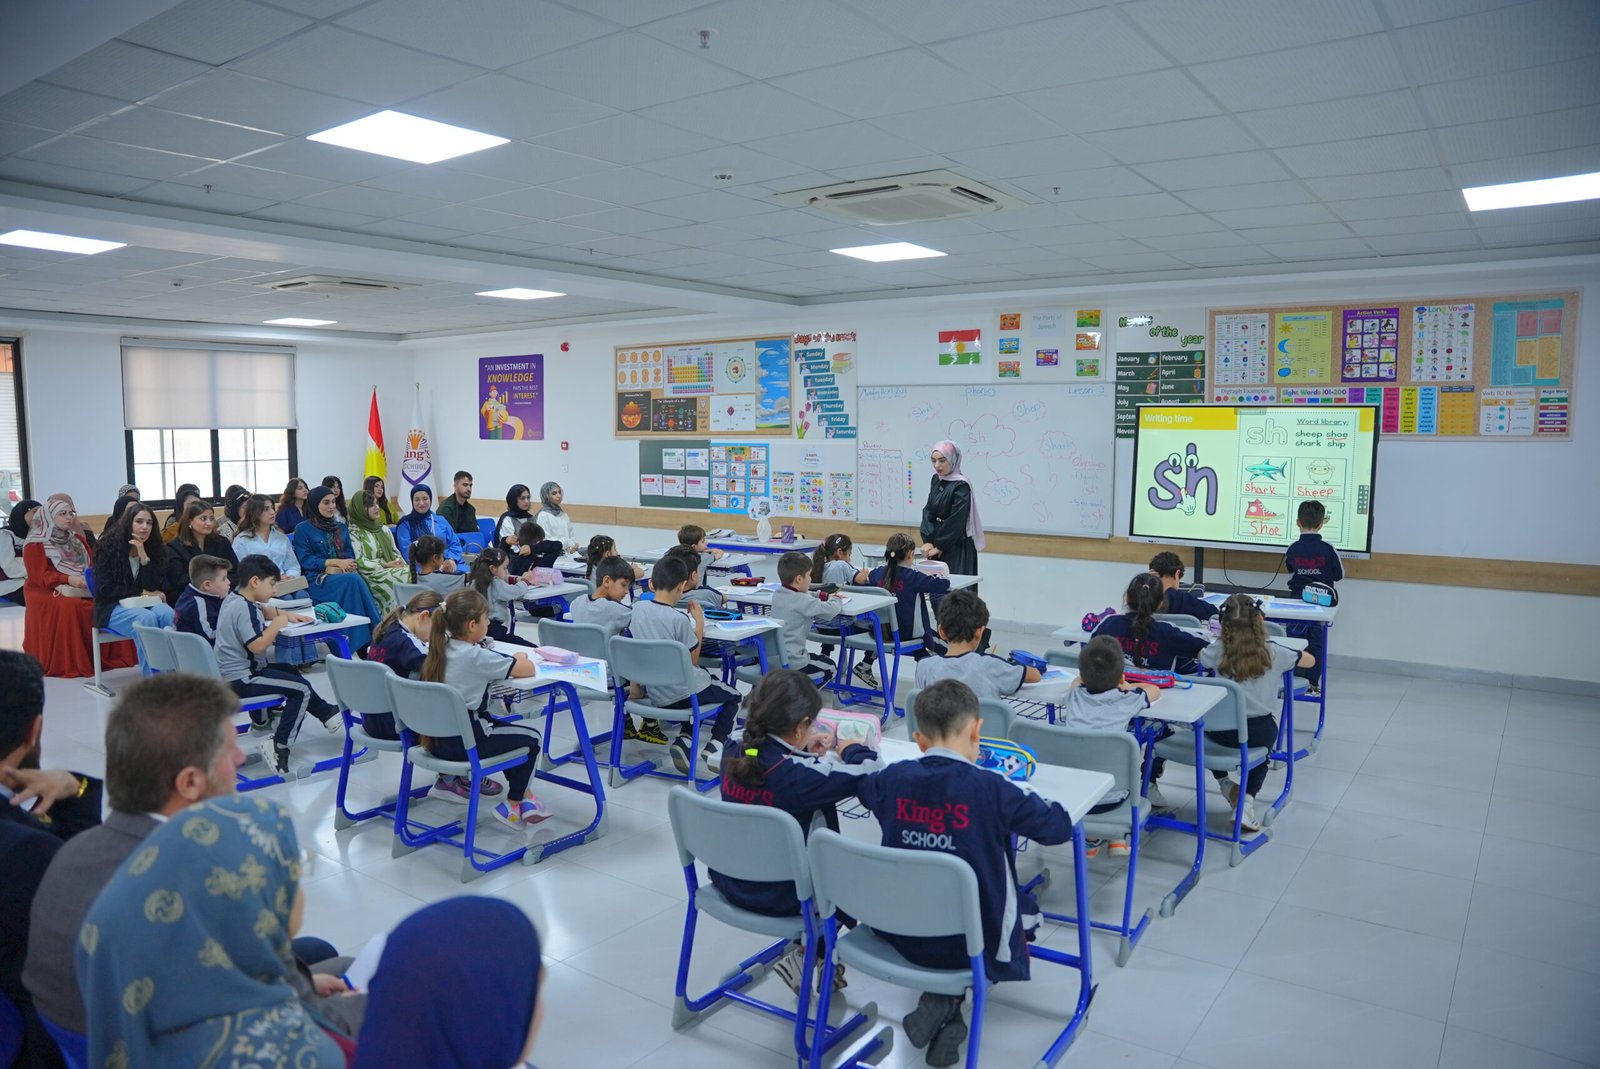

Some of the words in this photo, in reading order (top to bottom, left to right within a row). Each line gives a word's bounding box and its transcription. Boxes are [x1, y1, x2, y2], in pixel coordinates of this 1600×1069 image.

[1149, 326, 1160, 337] of
[1162, 326, 1179, 337] the
[1181, 335, 1204, 347] year
[1117, 356, 1140, 364] January
[1162, 354, 1188, 362] February
[495, 362, 529, 371] INVESTMENT
[487, 372, 534, 383] KNOWLEDGE
[1162, 369, 1176, 377] April
[1117, 385, 1130, 393] May
[1282, 388, 1299, 397] Sight
[1116, 399, 1129, 407] July
[1144, 414, 1173, 424] Writing
[1174, 414, 1193, 423] time
[1246, 418, 1288, 445] sh
[1295, 430, 1323, 440] sheep
[1326, 430, 1348, 438] shoe
[1327, 440, 1346, 449] ship
[1148, 442, 1218, 516] sh
[1250, 521, 1282, 536] Shoe
[896, 798, 970, 833] King'S
[902, 829, 957, 850] SCHOOL
